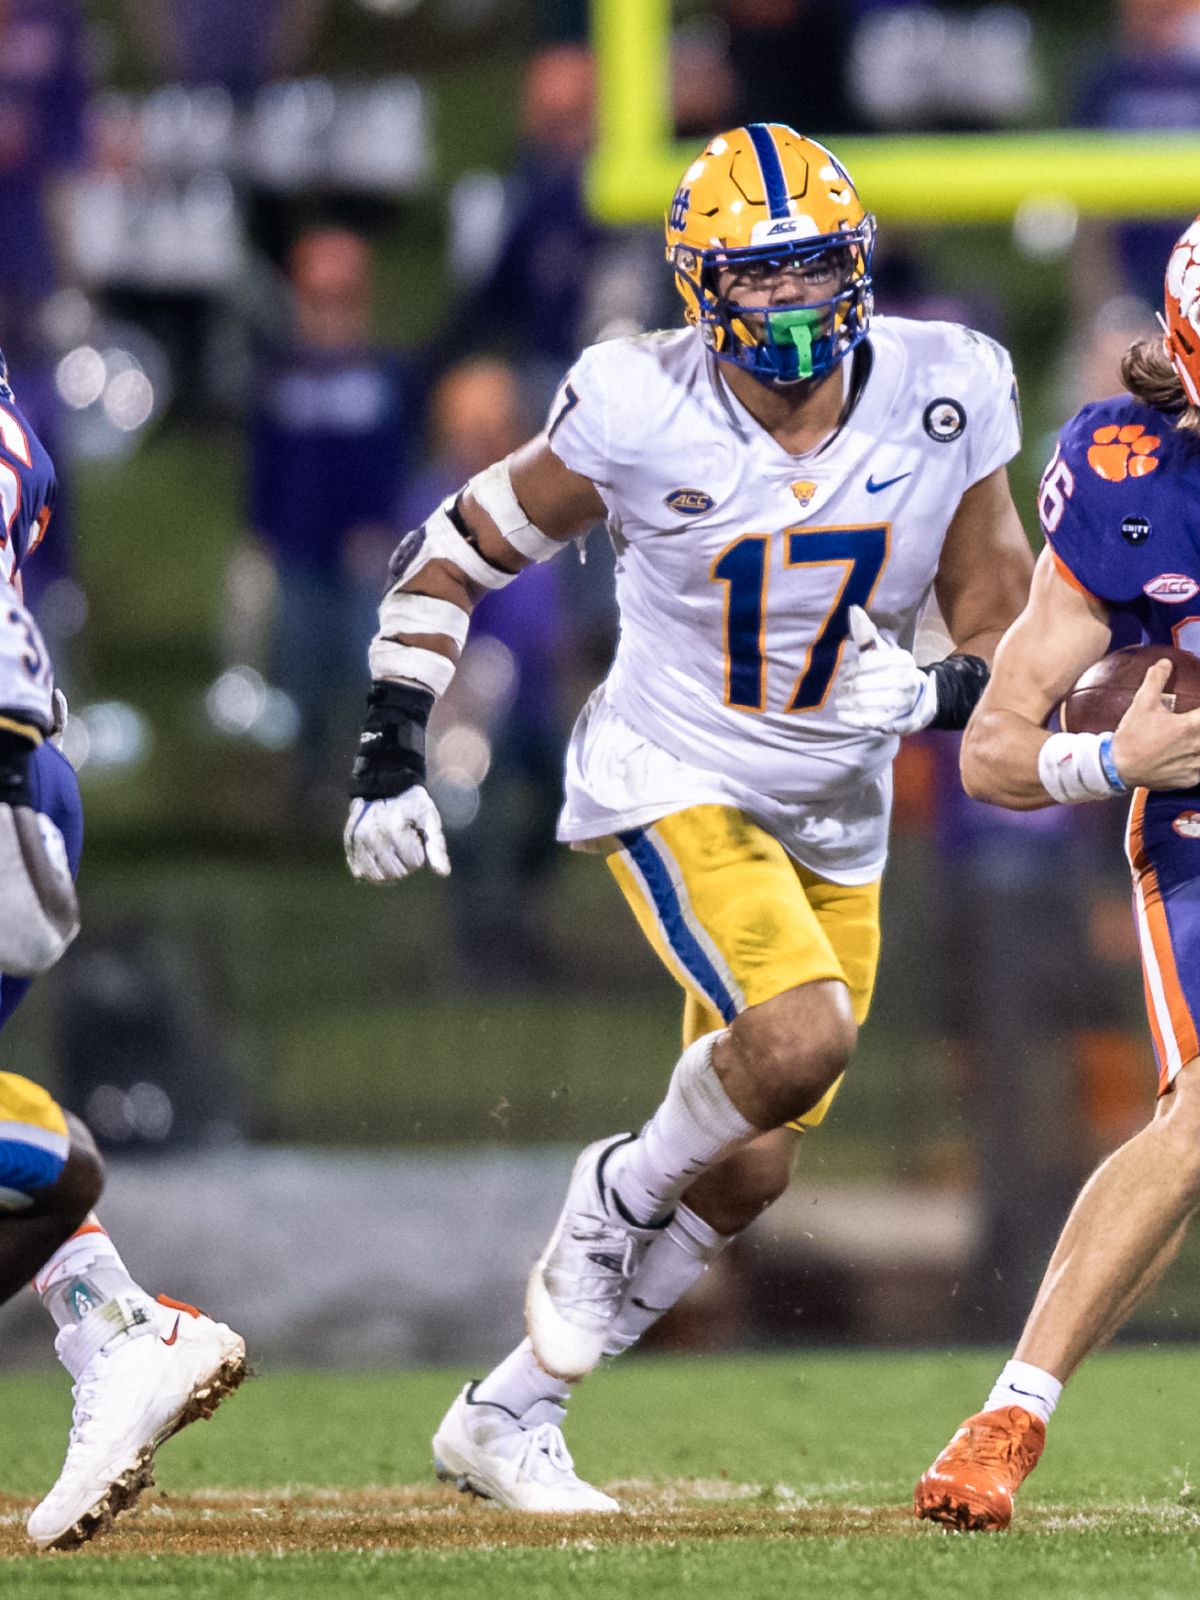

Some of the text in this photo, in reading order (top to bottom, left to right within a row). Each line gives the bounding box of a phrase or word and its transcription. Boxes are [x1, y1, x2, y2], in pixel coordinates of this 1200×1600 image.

[766, 220, 797, 236] ACC
[670, 494, 709, 509] ACC
[1122, 524, 1149, 534] UNITY
[1149, 582, 1191, 595] ACC
[709, 522, 893, 714] 17
